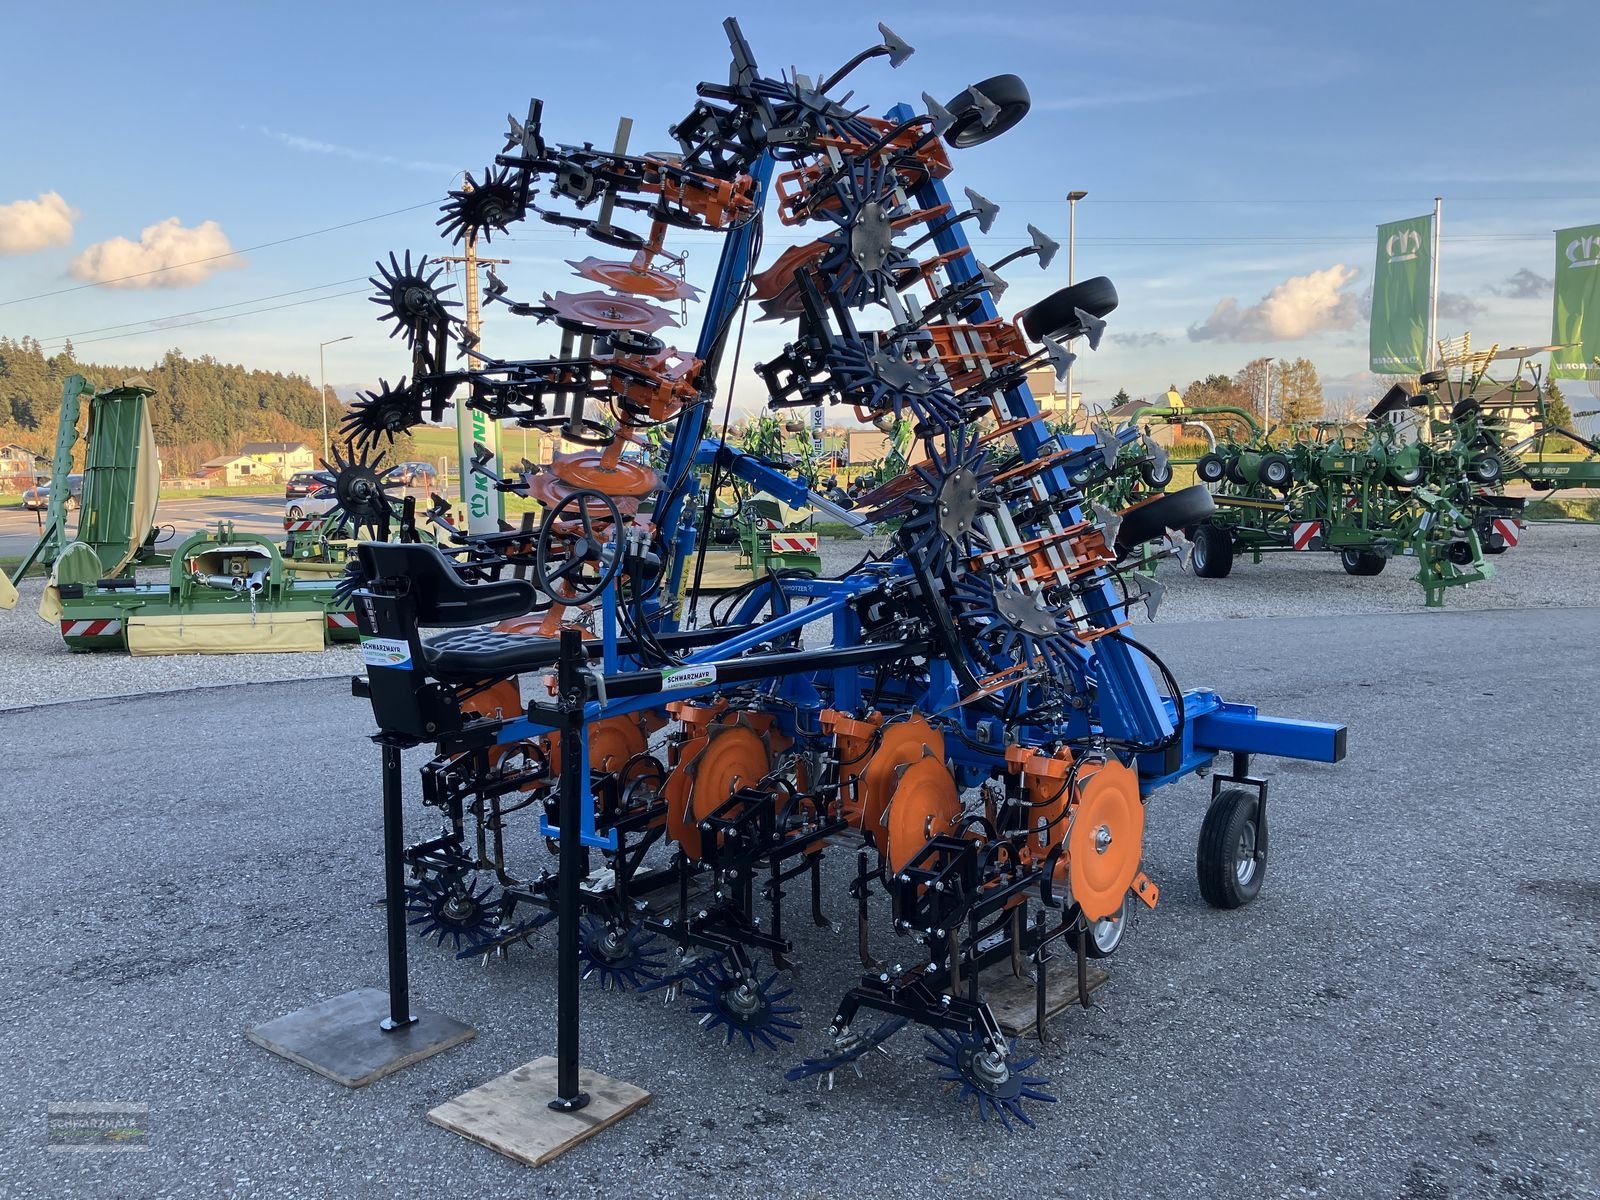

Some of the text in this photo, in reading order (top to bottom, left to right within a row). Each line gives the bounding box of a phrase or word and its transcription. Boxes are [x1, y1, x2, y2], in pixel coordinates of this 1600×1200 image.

[473, 408, 488, 492] KNE
[362, 642, 401, 653] SCHWARZMAYR
[667, 671, 710, 683] SCHWARZMAYR
